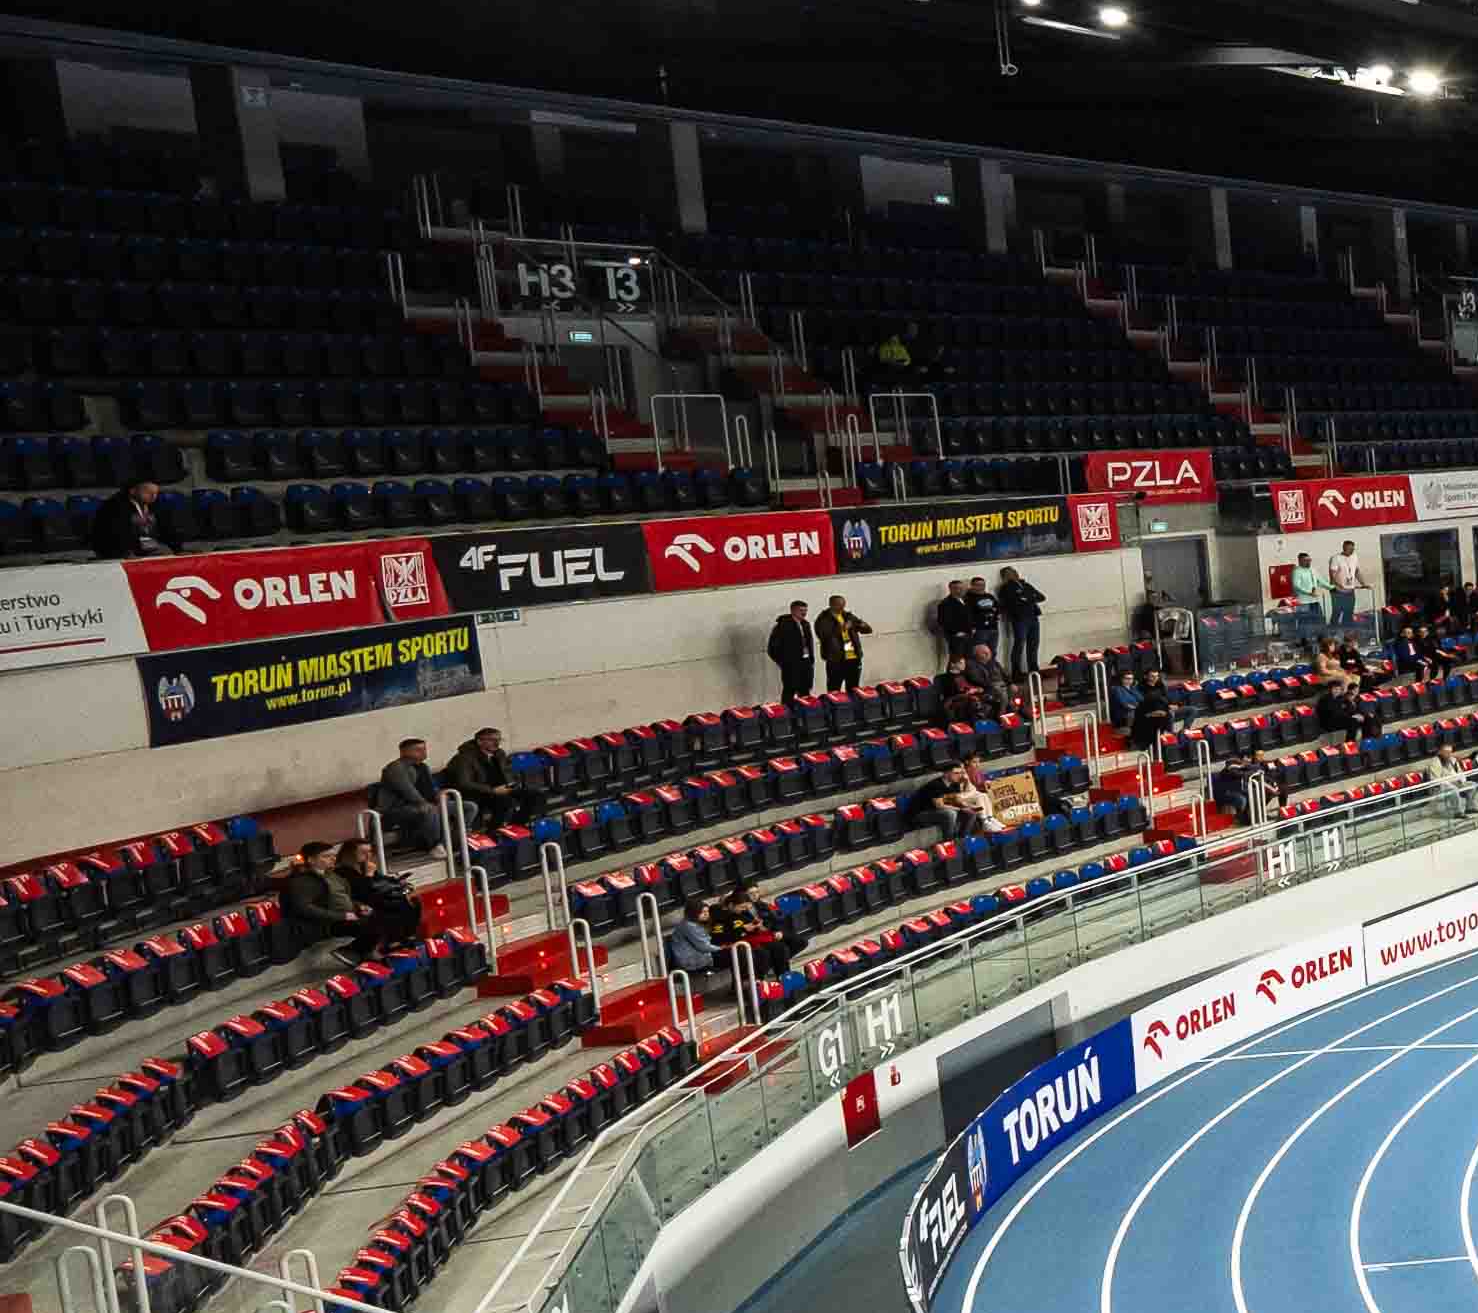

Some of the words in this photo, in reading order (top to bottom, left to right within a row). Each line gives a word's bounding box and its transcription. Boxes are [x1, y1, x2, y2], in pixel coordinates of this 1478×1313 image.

[518, 263, 576, 298] H3
[1107, 458, 1201, 488] PZLA
[1350, 489, 1406, 511] ORLEN
[936, 510, 1004, 538] MIASTEM
[1007, 504, 1060, 528] SPORTU
[460, 544, 496, 571] 4F
[724, 531, 820, 562] ORLEN
[497, 546, 625, 591] FUEL
[233, 570, 356, 610] ORLEN
[24, 608, 104, 634] Turystyki
[211, 653, 293, 704] TORUŃ
[298, 640, 393, 686] MIASTEM
[398, 627, 469, 666] SPORTU
[265, 676, 352, 712] www.torun.pl
[1266, 840, 1297, 880] H1
[1290, 945, 1354, 989] ORLEN
[865, 992, 903, 1047] H1
[1175, 991, 1238, 1041] ORLEN
[818, 1021, 846, 1077] G1
[1002, 1046, 1102, 1166] TORUŃ
[930, 1173, 966, 1263] FUEL
